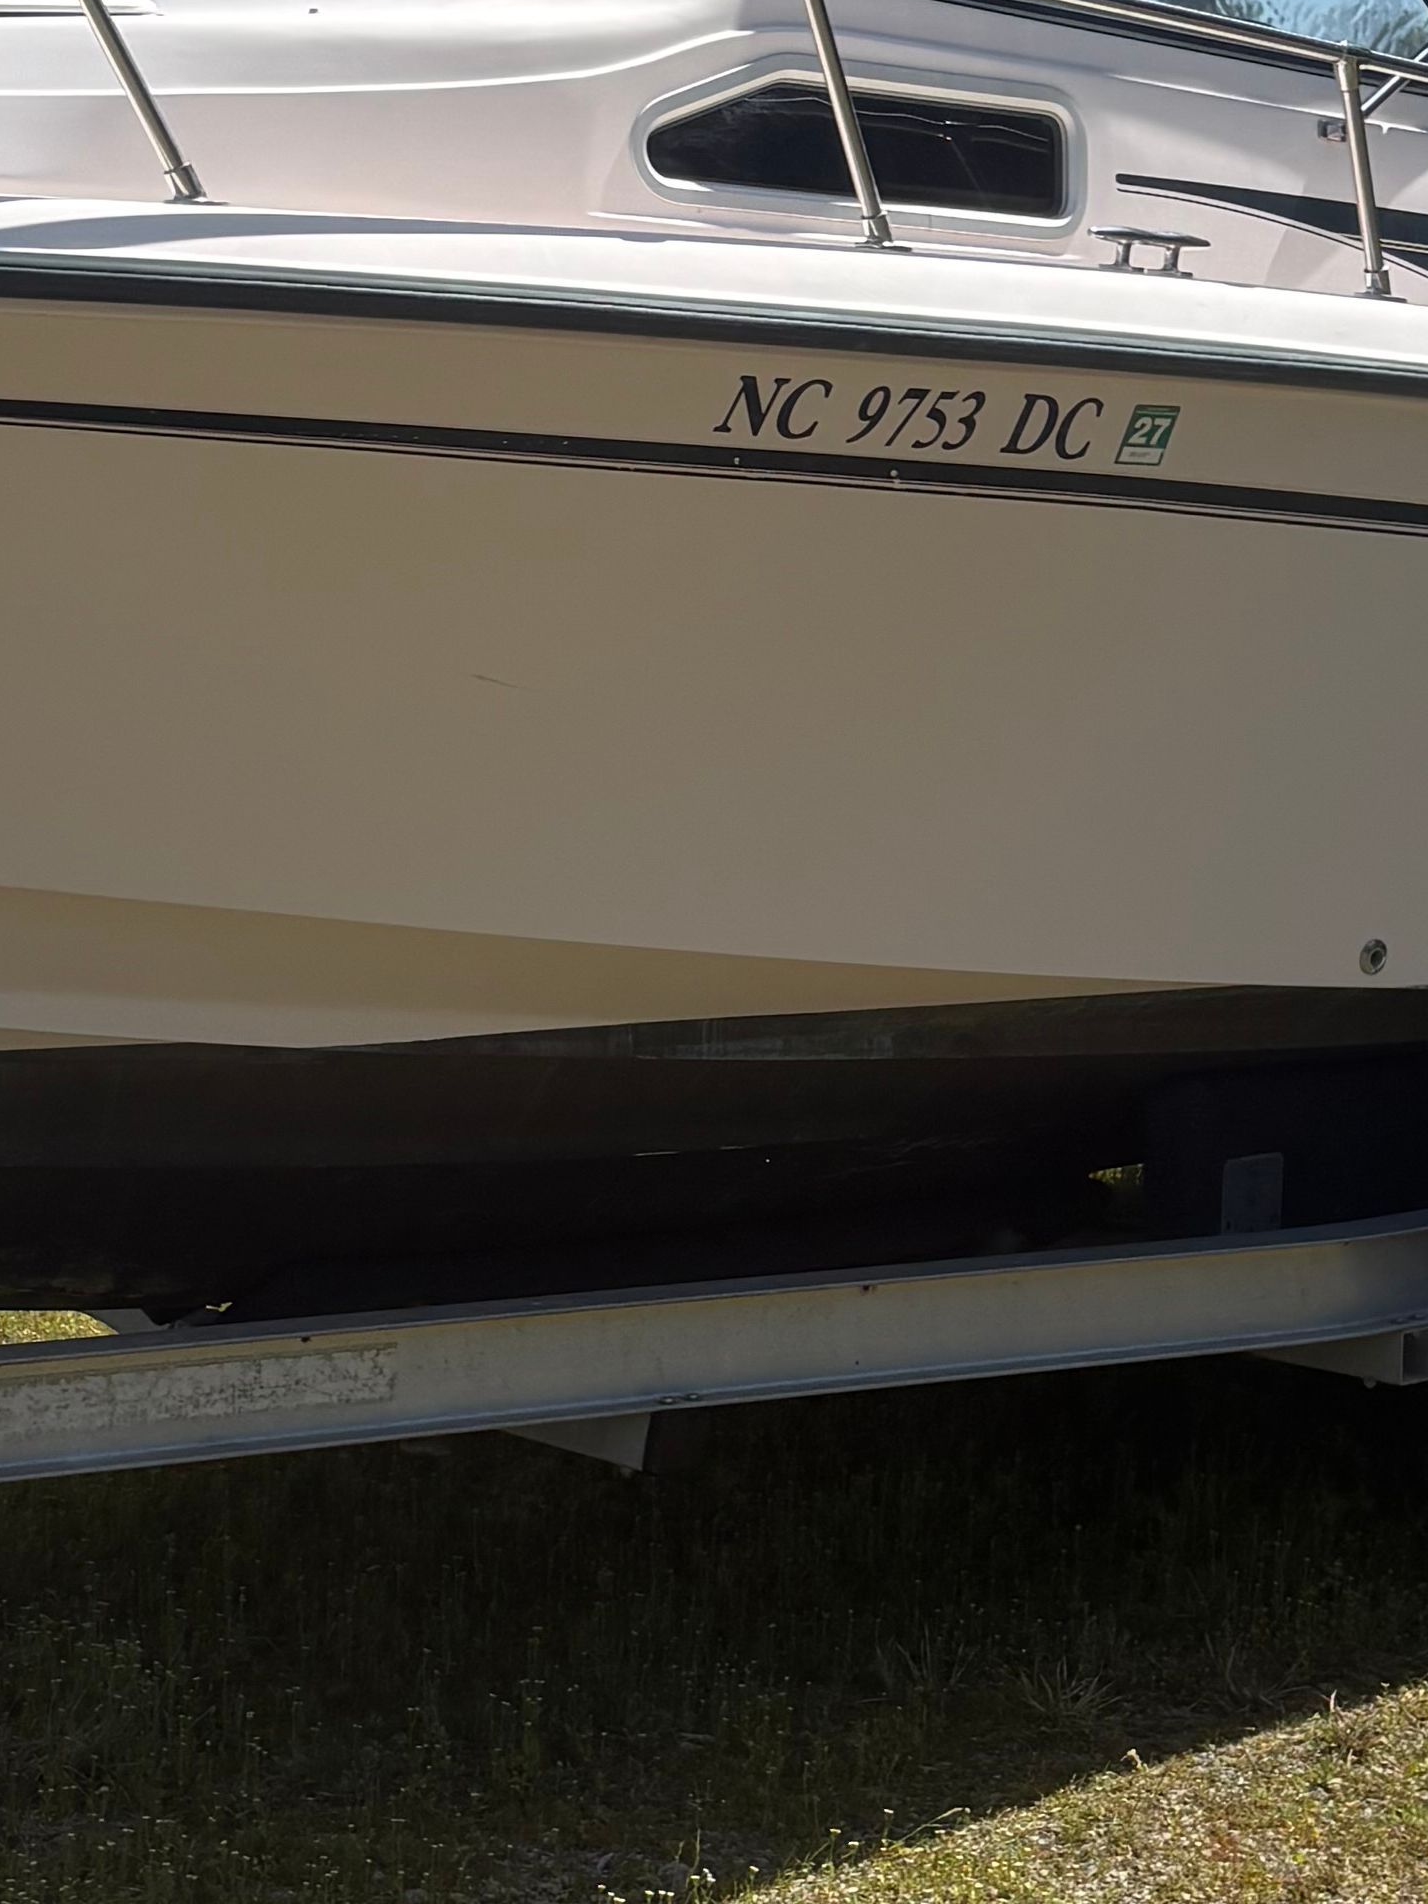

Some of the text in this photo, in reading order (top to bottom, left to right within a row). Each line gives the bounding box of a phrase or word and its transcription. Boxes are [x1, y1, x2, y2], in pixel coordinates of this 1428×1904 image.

[713, 375, 1104, 460] NC 9753 DC
[1128, 416, 1172, 445] 27
